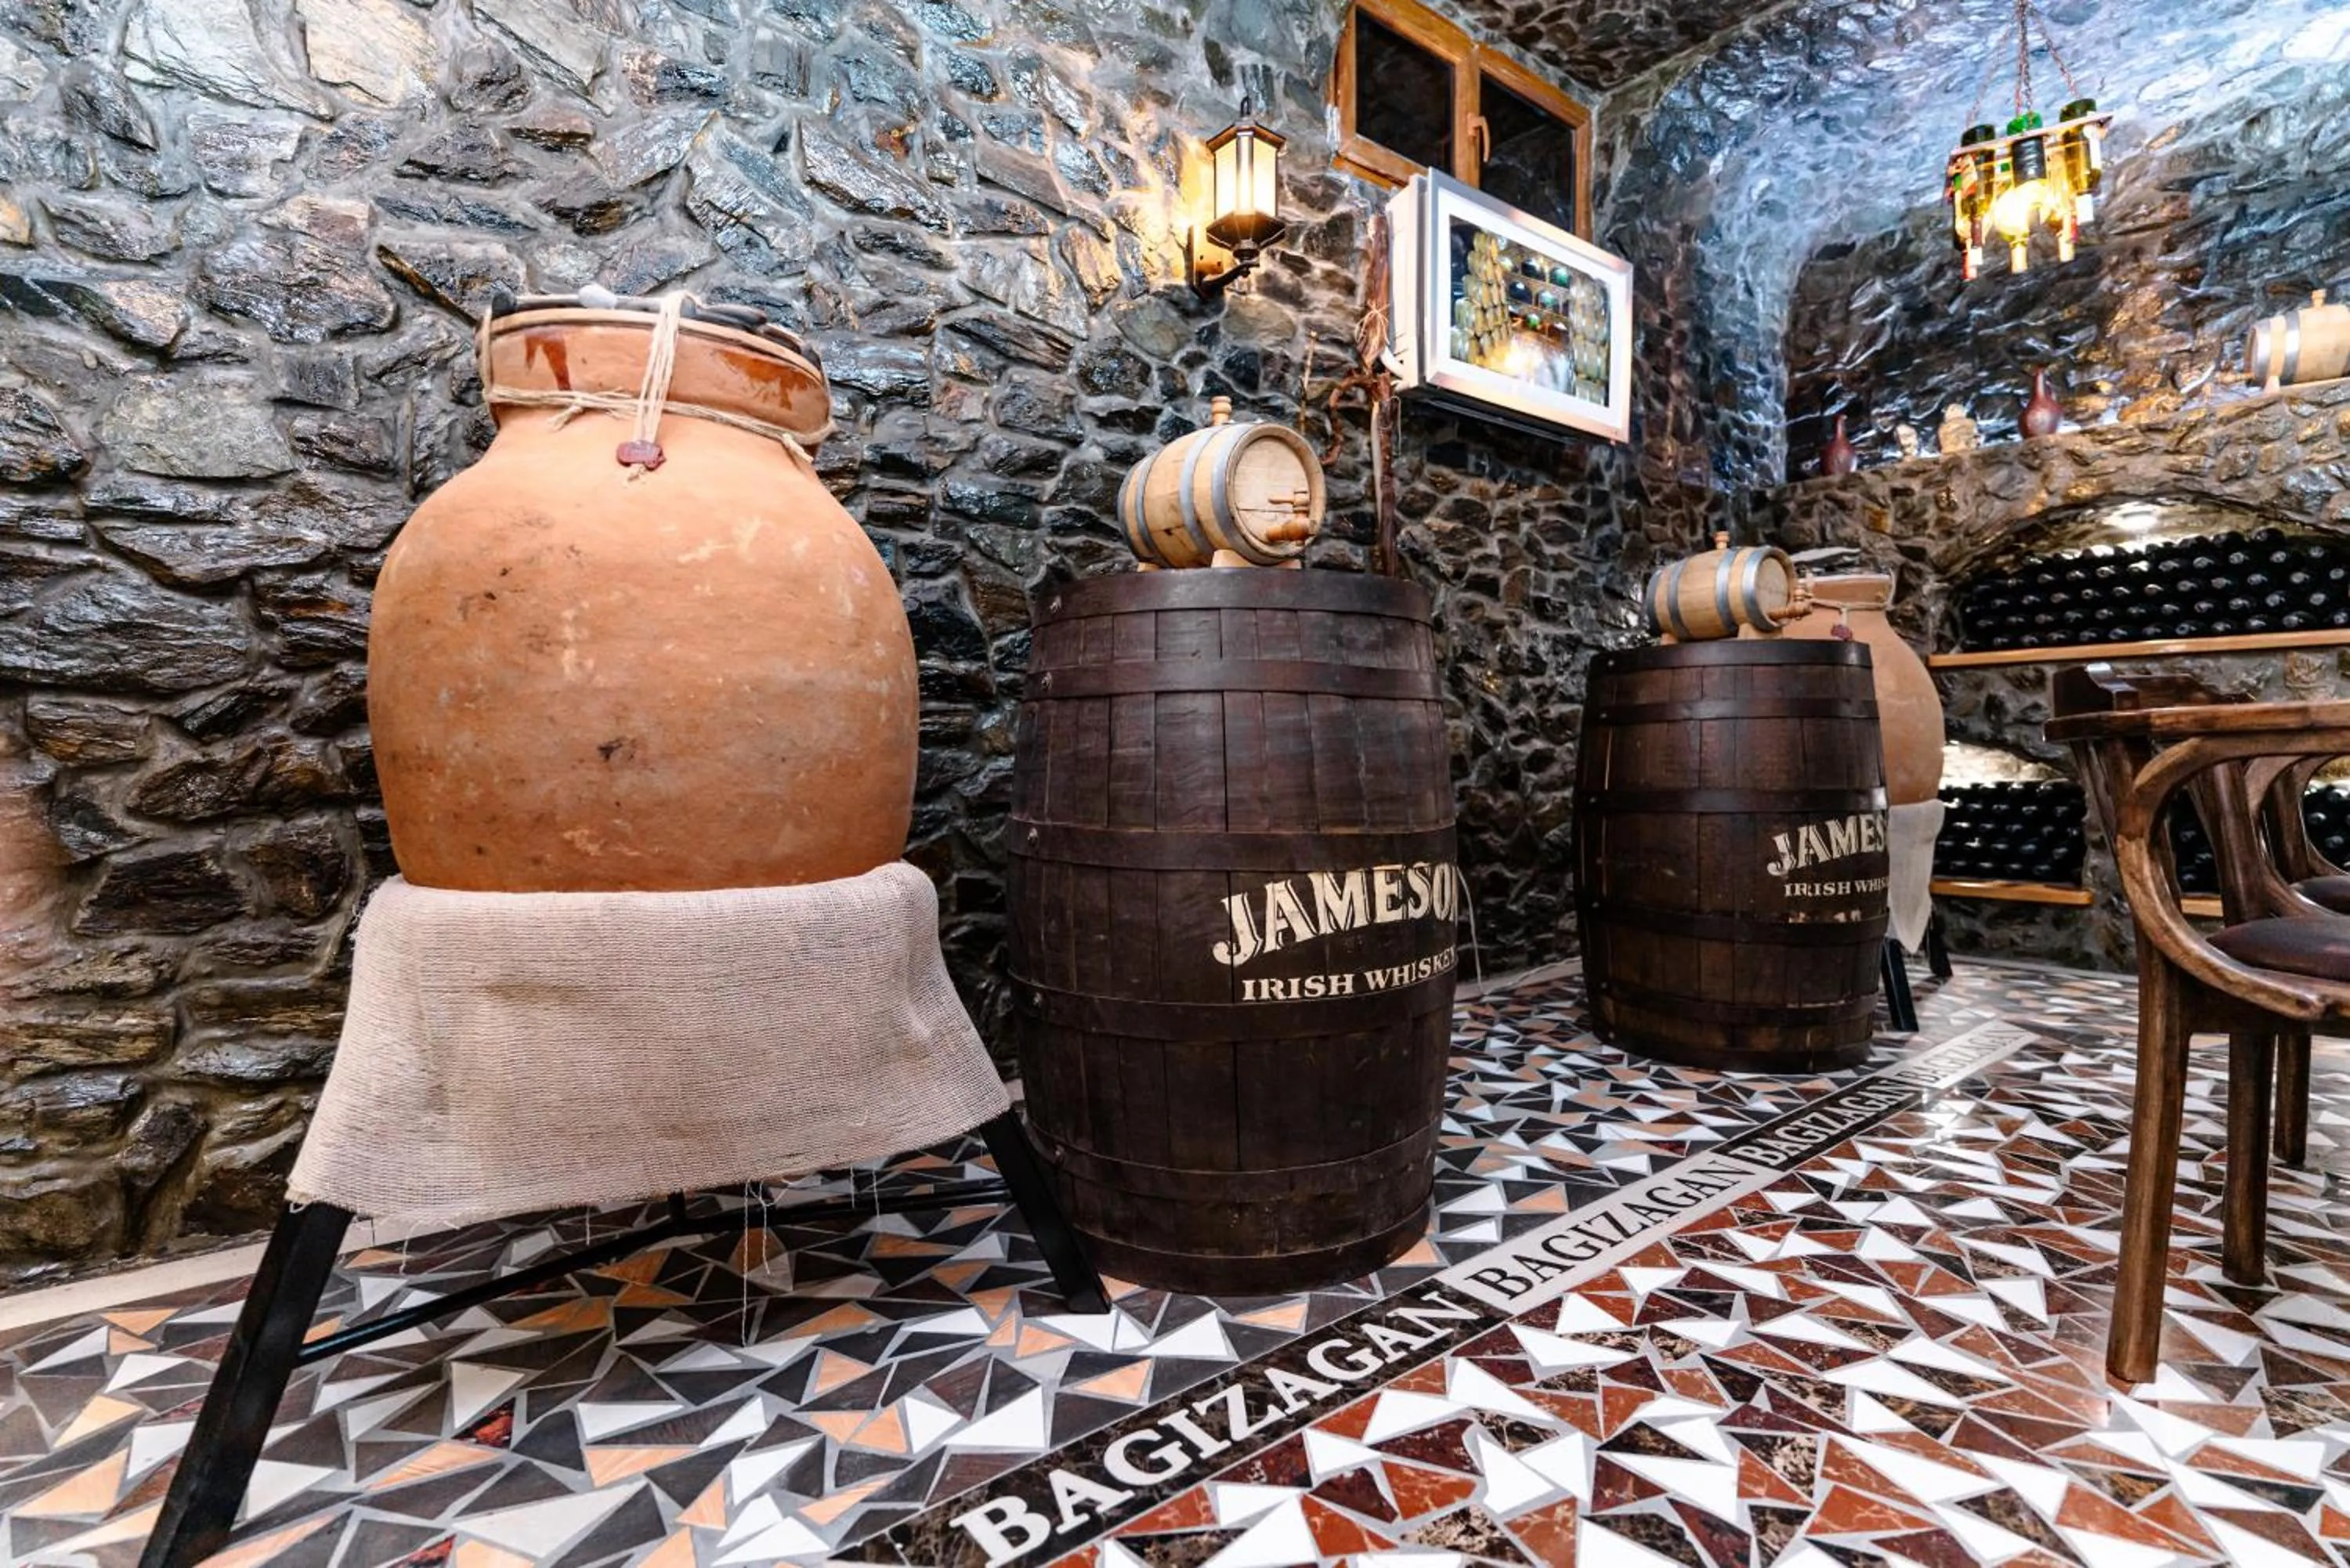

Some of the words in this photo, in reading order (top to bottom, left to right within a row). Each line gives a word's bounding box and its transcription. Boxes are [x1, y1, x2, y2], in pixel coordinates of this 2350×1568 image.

[1784, 881, 1851, 897] IRISH
[1242, 974, 1354, 1001] IRISH
[949, 1291, 1480, 1568] BAGIZAGAN
[1464, 1159, 1755, 1300] BAGIZAGAN
[1730, 1079, 1922, 1166] BAGIZAGAN
